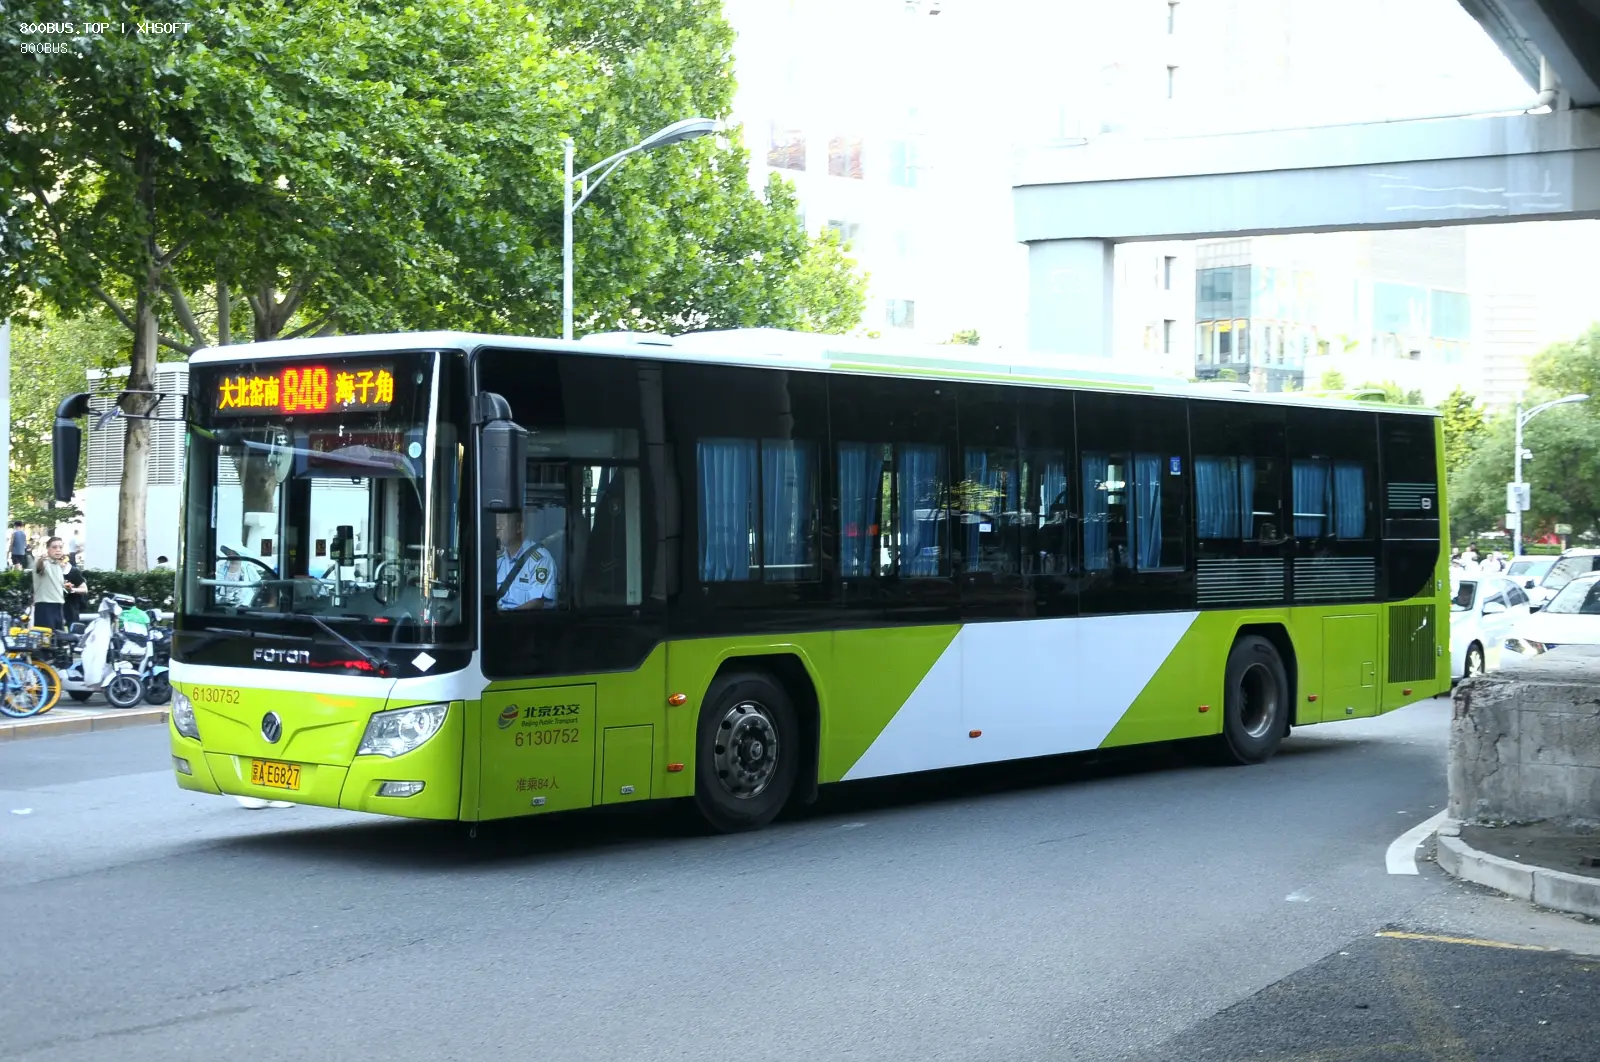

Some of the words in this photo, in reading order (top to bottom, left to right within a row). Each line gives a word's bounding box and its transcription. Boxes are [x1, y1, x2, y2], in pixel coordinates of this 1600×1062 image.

[282, 367, 329, 412] 848
[253, 648, 310, 664] FOTON
[192, 686, 240, 704] 6130752
[522, 704, 580, 719] 北京公交
[521, 720, 539, 728] Beijing
[554, 717, 578, 725] Transport
[515, 728, 579, 747] 6130752
[515, 776, 560, 792] 准乘84人
